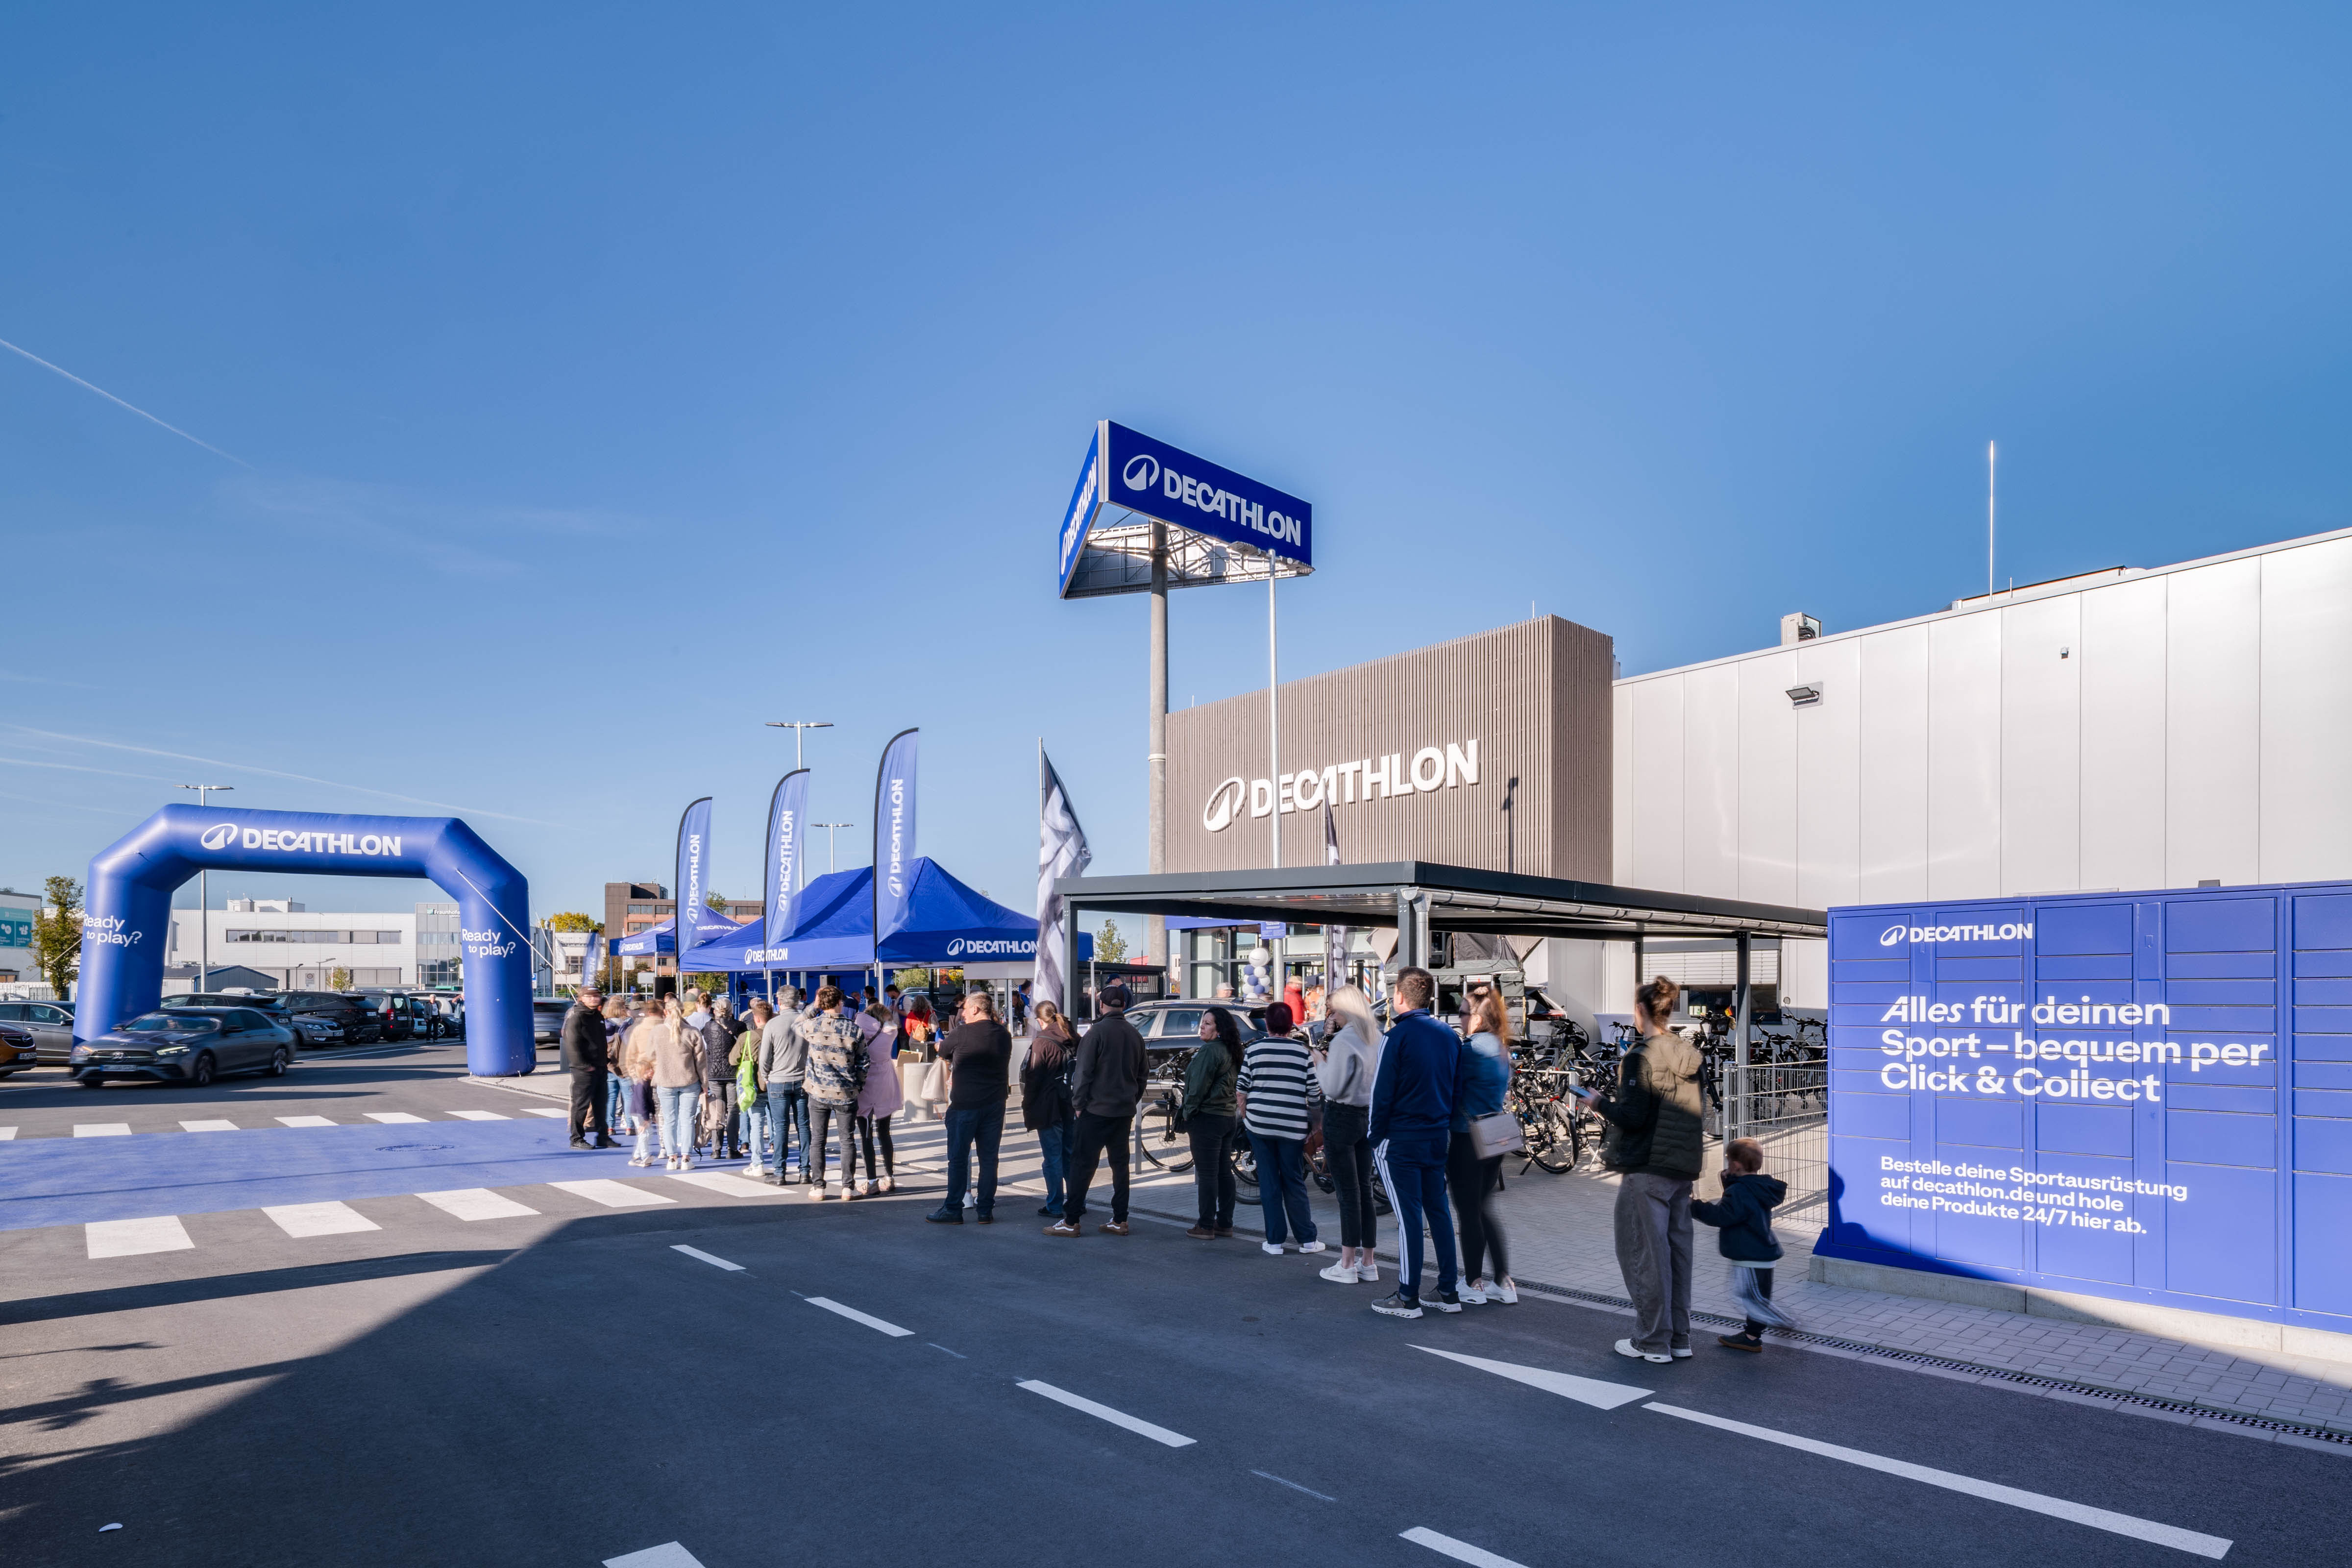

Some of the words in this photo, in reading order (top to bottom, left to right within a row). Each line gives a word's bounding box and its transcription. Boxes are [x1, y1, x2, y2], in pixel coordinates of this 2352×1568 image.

[1067, 455, 1097, 557] DECATHLON
[1164, 467, 1301, 546] DECATHLON
[1251, 739, 1479, 818] DECATHLON
[243, 828, 401, 856] DECATHLON
[890, 779, 904, 874] DECATHLON
[688, 834, 700, 906] DECATHLON
[780, 810, 793, 892] DECATHLON
[83, 913, 125, 932] Ready
[86, 931, 95, 939] to
[97, 930, 143, 947] play?
[462, 929, 501, 944] Ready
[1910, 923, 2033, 943] DECATHLON
[468, 945, 477, 953] to
[480, 941, 516, 958] play?
[967, 940, 1039, 954] DECATHLON
[1880, 996, 1965, 1023] Alles
[1970, 996, 2026, 1023] für
[2031, 996, 2170, 1025] deinen
[1881, 1029, 1981, 1062] Sport
[2014, 1031, 2181, 1068] bequem
[2191, 1043, 2269, 1072] per
[1881, 1062, 1970, 1092] Click
[1976, 1066, 2007, 1094] &
[2012, 1067, 2160, 1102] Collect
[1881, 1156, 1952, 1176] Bestelle
[1954, 1163, 2007, 1180] deine
[2009, 1167, 2188, 1202] Sportausrüstung
[1881, 1176, 1910, 1190] auf
[1912, 1177, 2035, 1202] decathlon.de
[2036, 1192, 2075, 1207] und
[2079, 1193, 2124, 1212] hole
[1881, 1192, 1930, 1210] deine
[1932, 1196, 2019, 1220] Produkte
[2022, 1205, 2068, 1226] 24/7
[2071, 1211, 2111, 1230] hier
[2113, 1217, 2147, 1234] ab.
